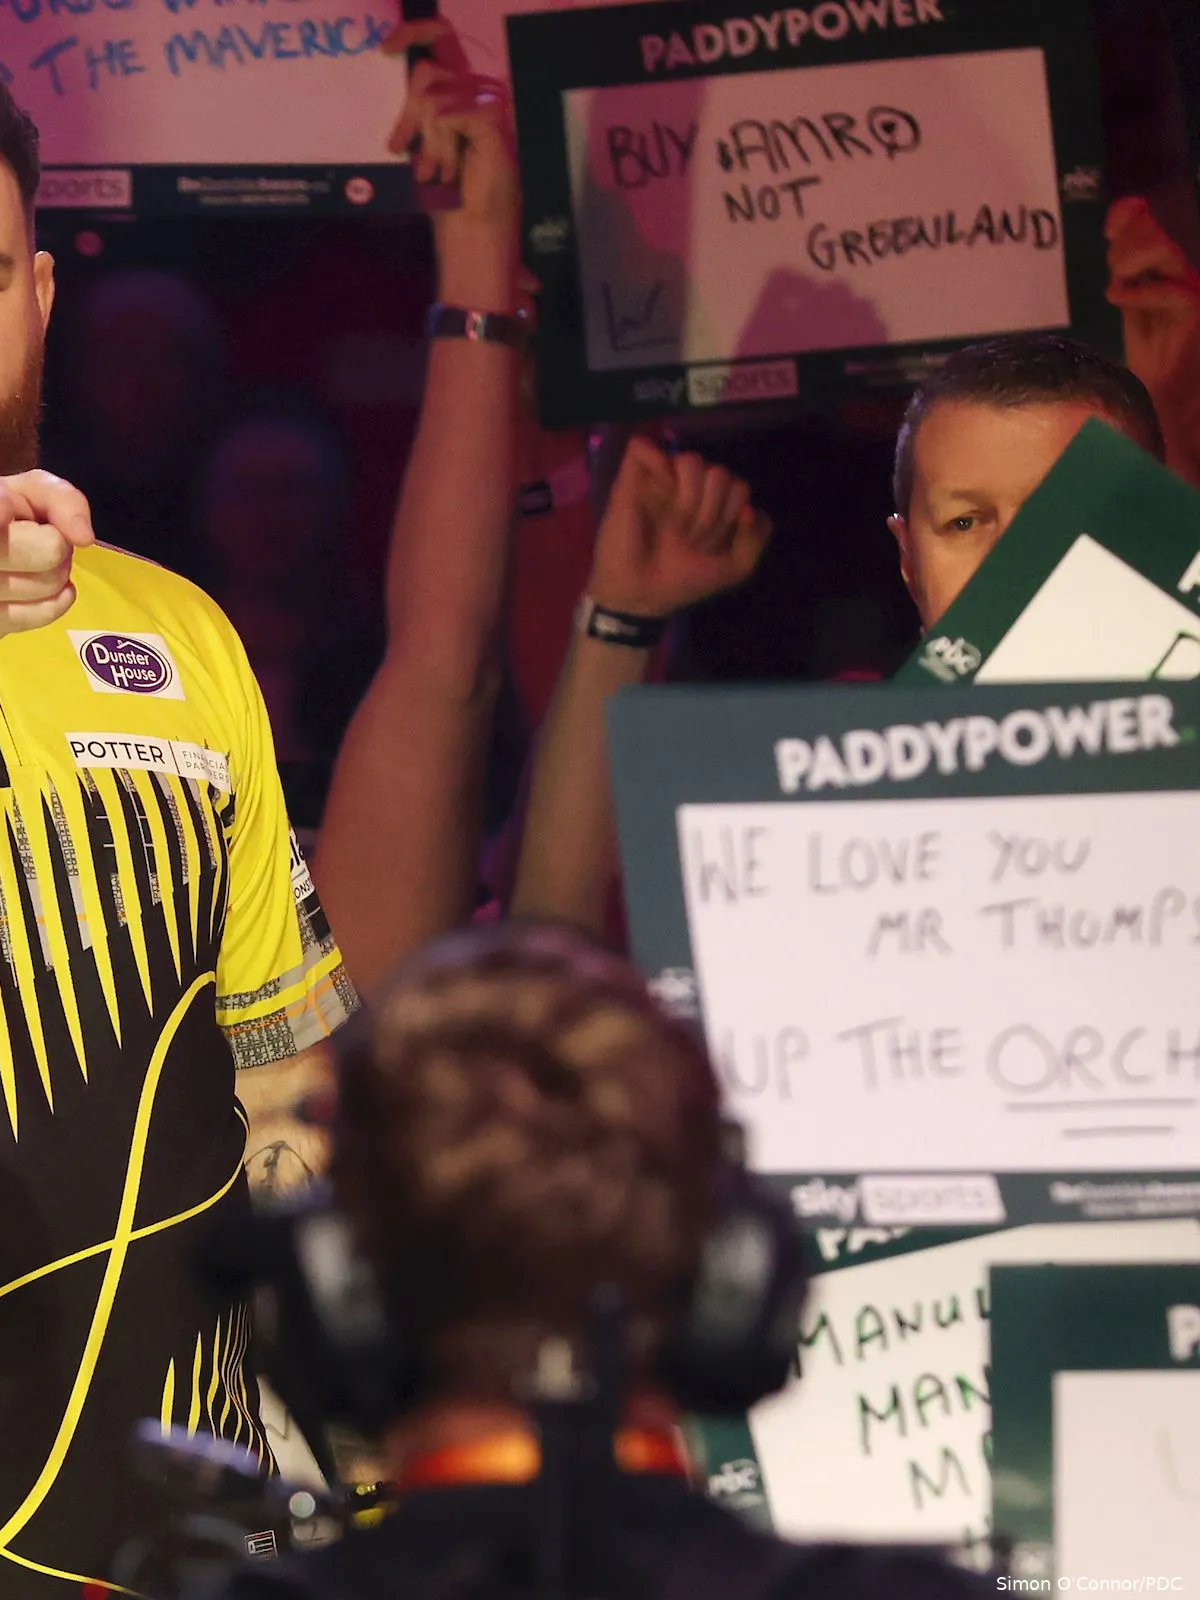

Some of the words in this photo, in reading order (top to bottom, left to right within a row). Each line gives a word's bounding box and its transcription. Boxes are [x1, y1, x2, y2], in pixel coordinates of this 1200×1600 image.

[640, 0, 946, 72] PADDYPOWER
[607, 120, 697, 190] BUY
[722, 176, 822, 223] NOT
[806, 203, 1059, 271] GREENLAND
[91, 642, 150, 666] Dunster
[110, 664, 158, 688] House
[70, 740, 166, 764] POTTER
[696, 824, 770, 902] WE
[807, 828, 942, 899] LOVE
[985, 828, 1092, 884] YOU
[865, 906, 954, 957] MR
[836, 1016, 966, 1091] THE
